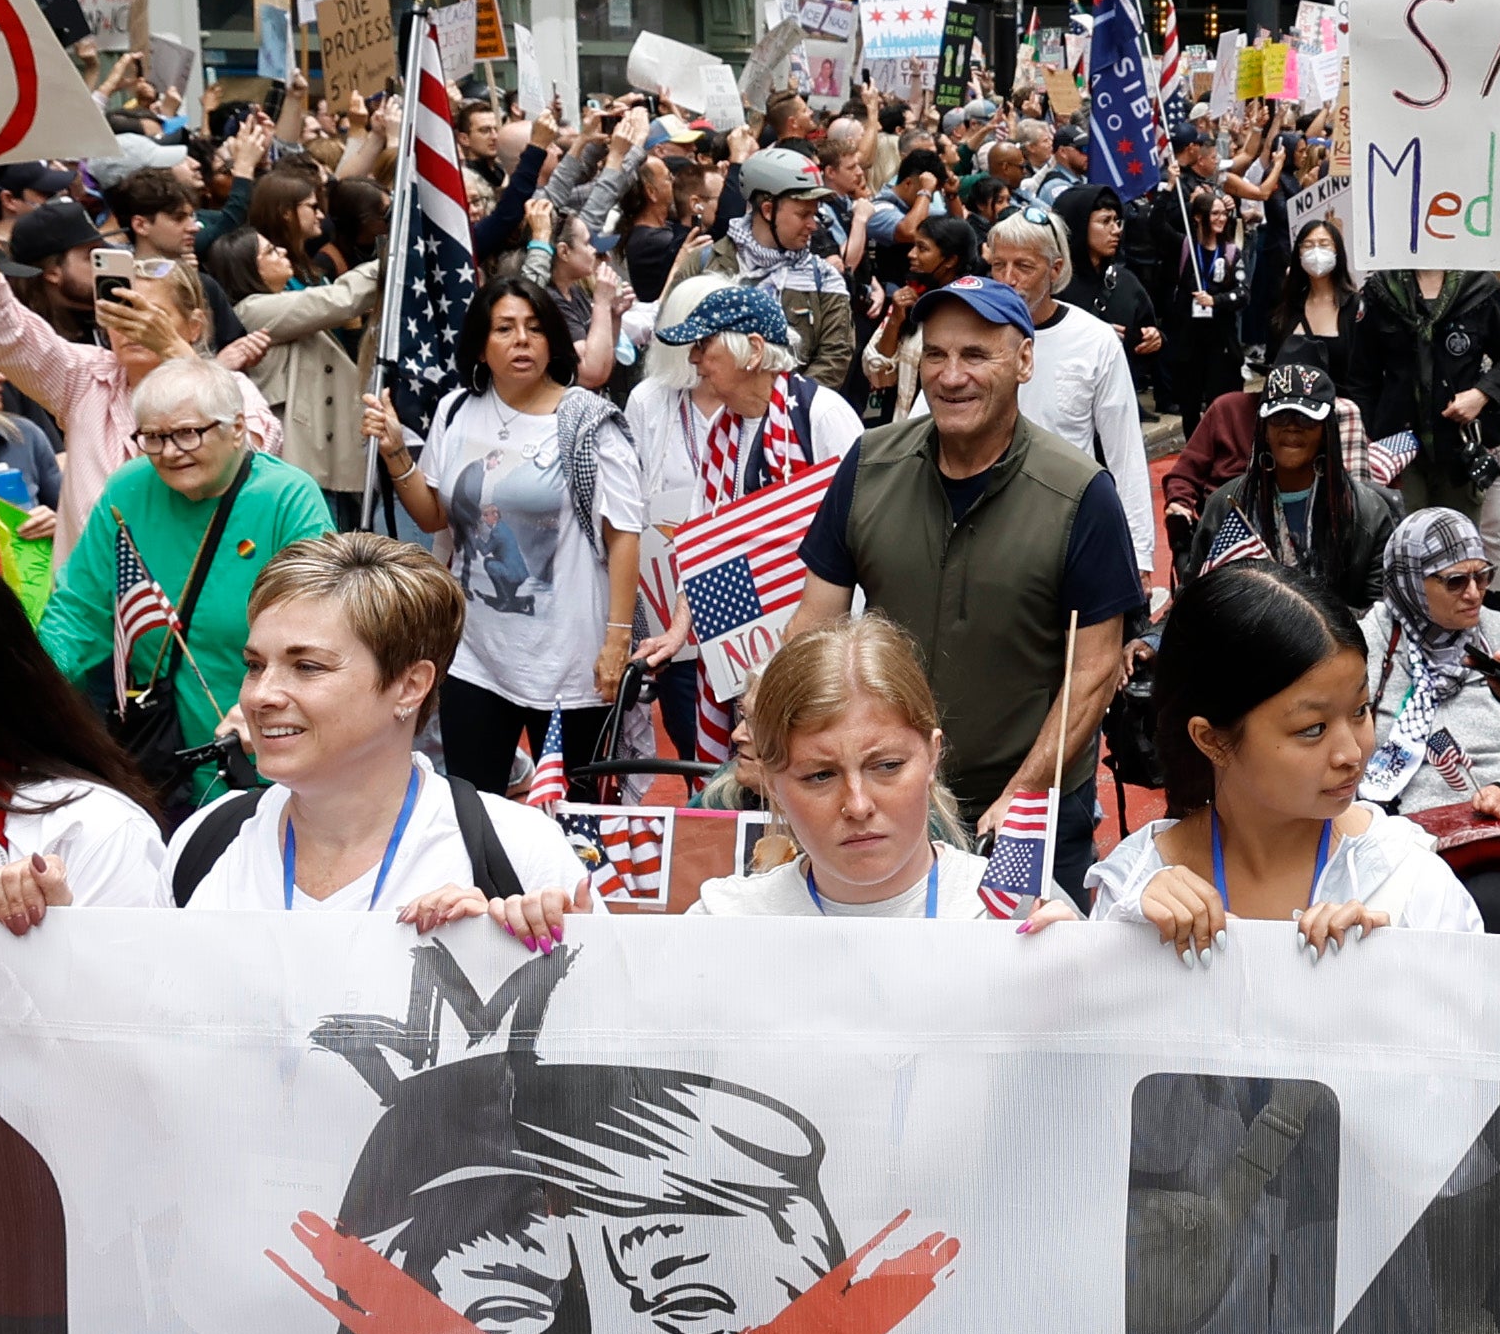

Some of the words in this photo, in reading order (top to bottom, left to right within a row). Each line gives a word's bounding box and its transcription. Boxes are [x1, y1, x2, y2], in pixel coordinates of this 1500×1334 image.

[803, 8, 822, 24] ICE
[322, 14, 392, 67] PROCESS
[1295, 187, 1315, 215] NO
[1268, 364, 1321, 399] NY
[718, 624, 776, 687] NO
